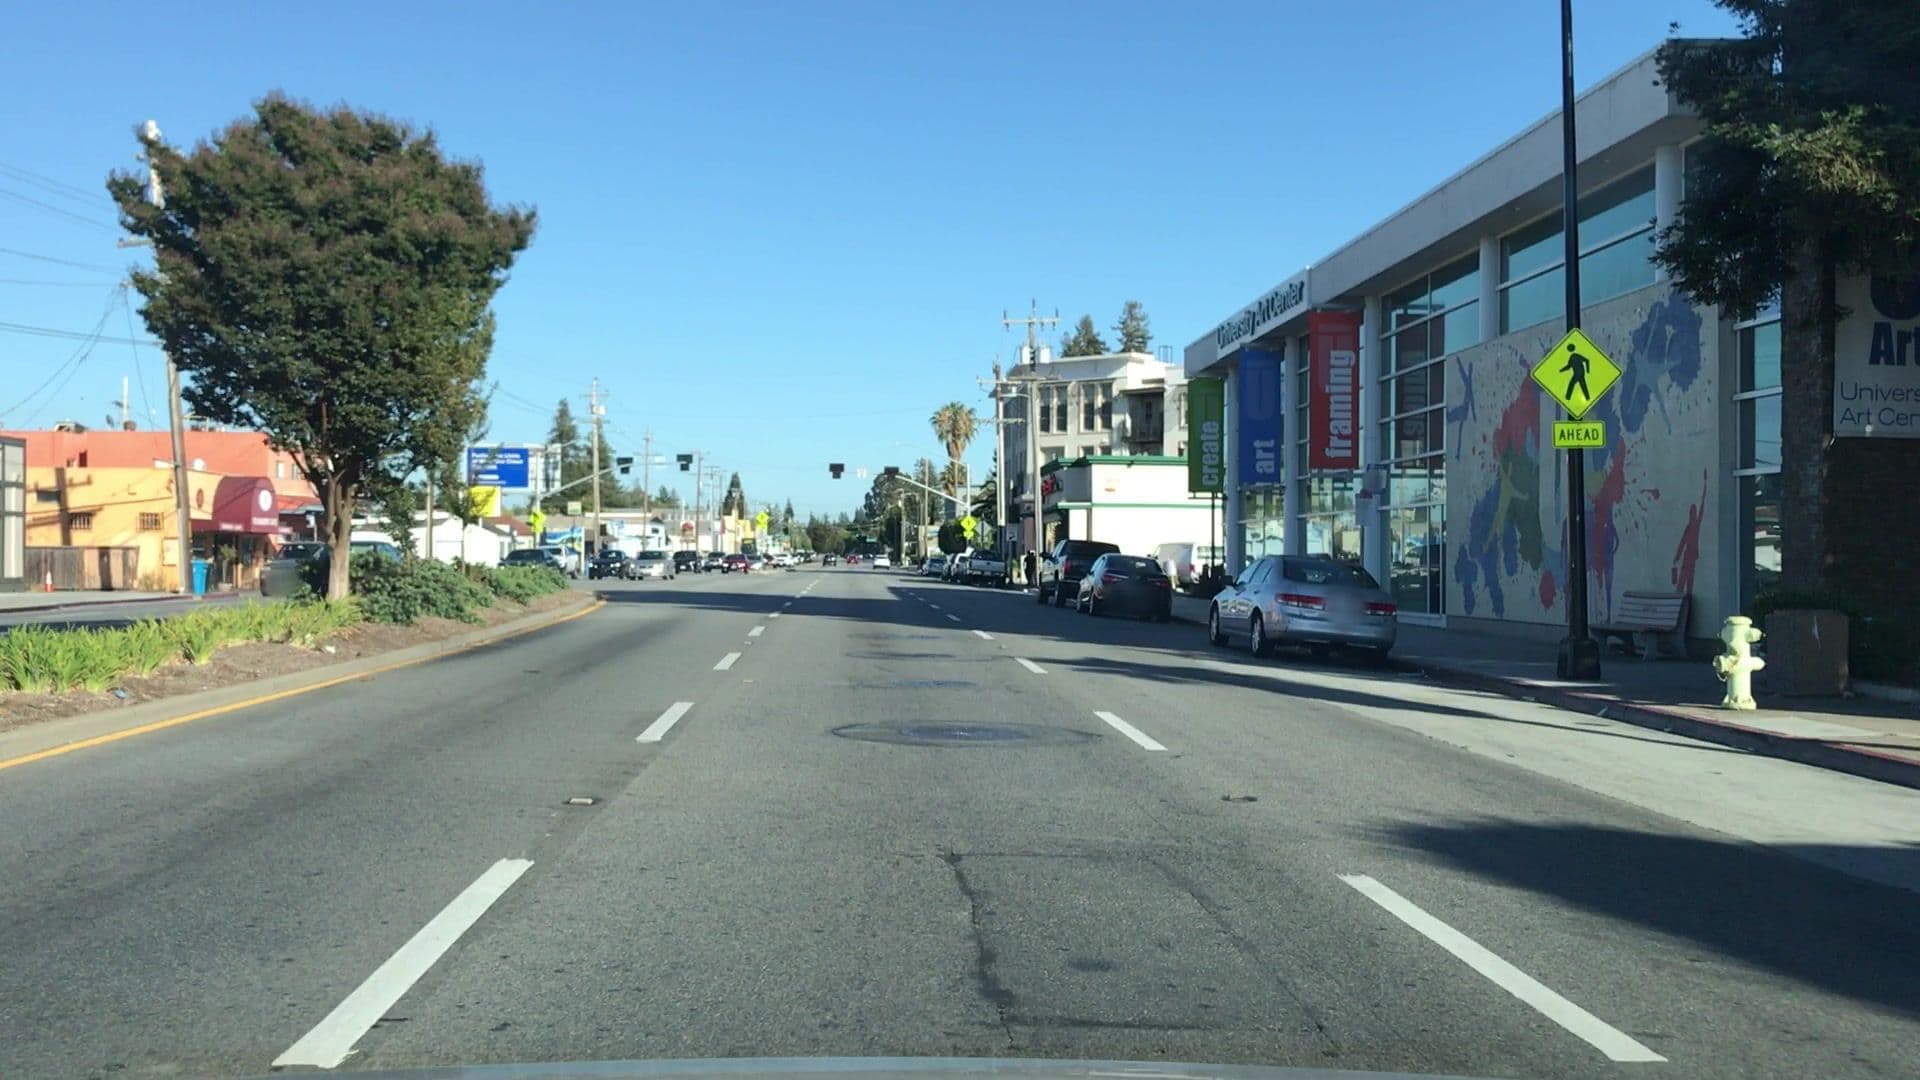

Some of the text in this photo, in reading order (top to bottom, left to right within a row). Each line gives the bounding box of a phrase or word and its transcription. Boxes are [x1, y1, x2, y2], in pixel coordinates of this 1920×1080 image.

[1325, 350, 1355, 457] framing
[1839, 407, 1872, 425] Art
[1559, 428, 1600, 441] AHEAD
[1201, 420, 1220, 485] create
[1254, 440, 1275, 475] art
